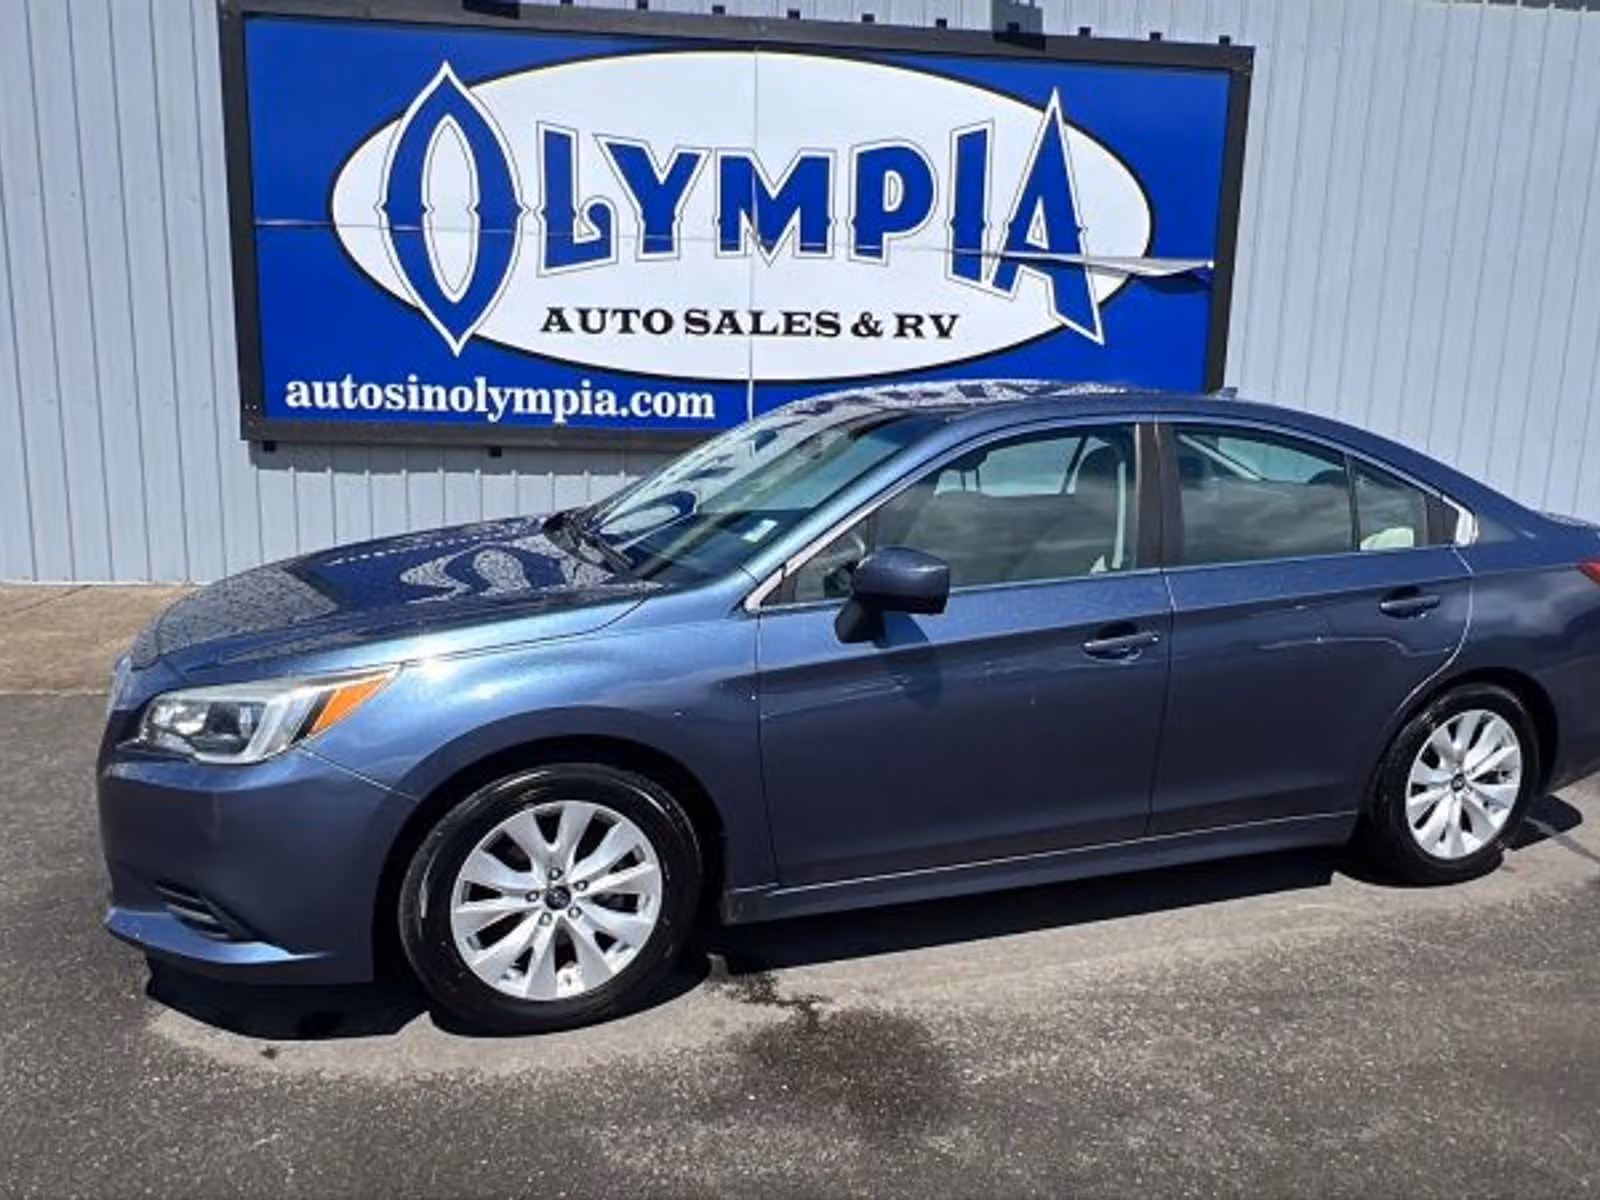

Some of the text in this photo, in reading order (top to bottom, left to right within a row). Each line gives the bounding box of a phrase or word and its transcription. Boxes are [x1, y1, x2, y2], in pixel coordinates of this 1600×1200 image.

[376, 61, 1104, 356] OLYMPIA
[541, 307, 960, 338] AUTO SALES & RV
[286, 374, 715, 422] autosinolympia.com
